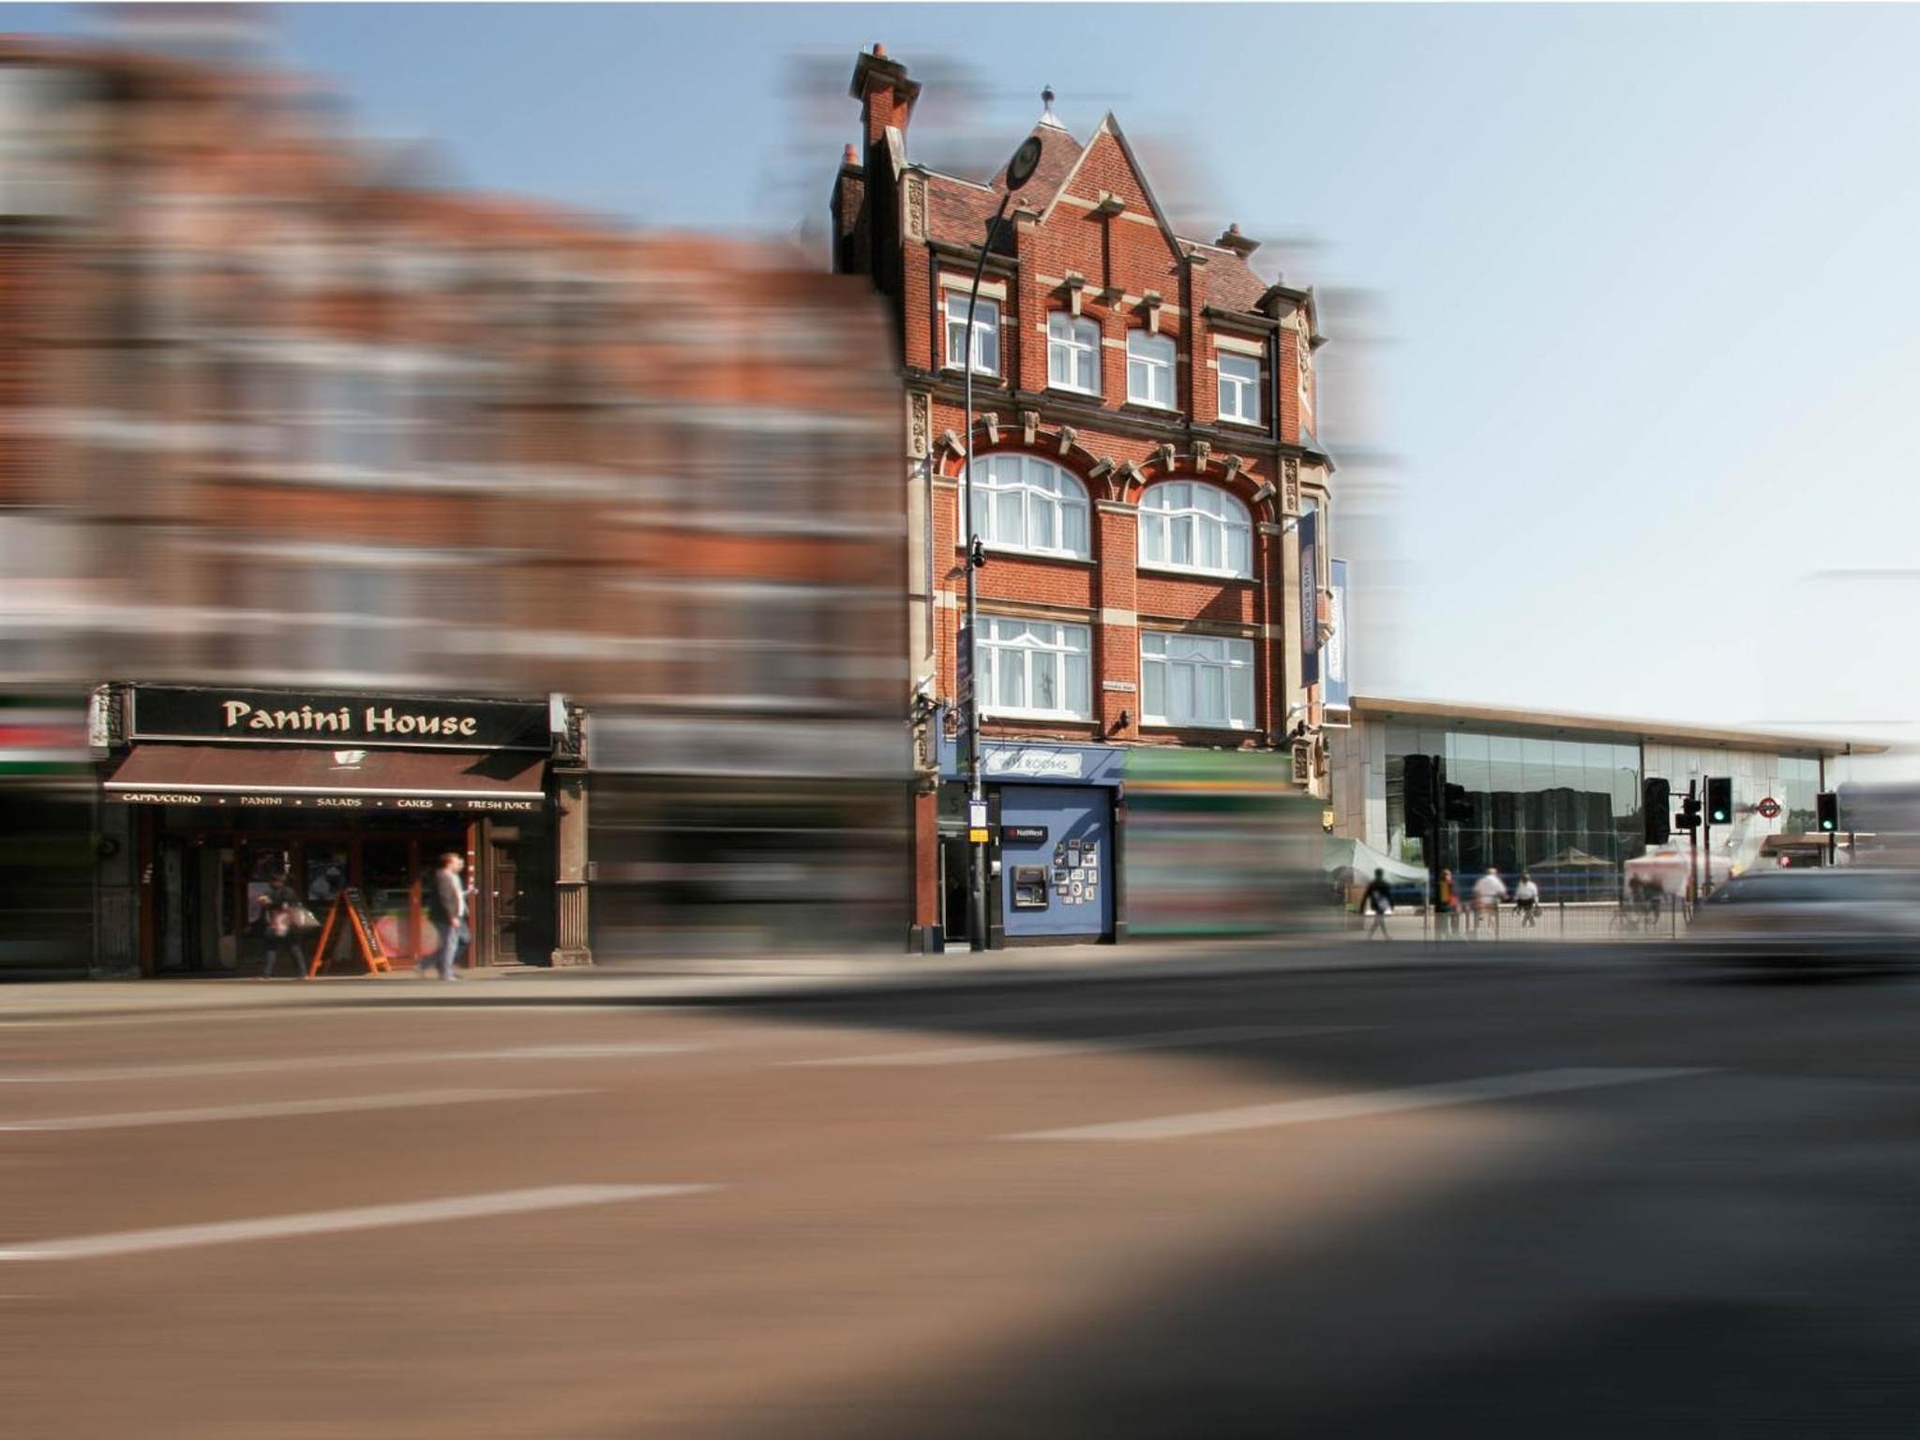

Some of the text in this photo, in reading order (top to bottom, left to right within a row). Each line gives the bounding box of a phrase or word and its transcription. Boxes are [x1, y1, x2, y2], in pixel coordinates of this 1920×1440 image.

[223, 701, 477, 736] Panini House
[123, 793, 531, 810] CAPPUCCINO PANINI SALADS CAKES FRESH JUICE
